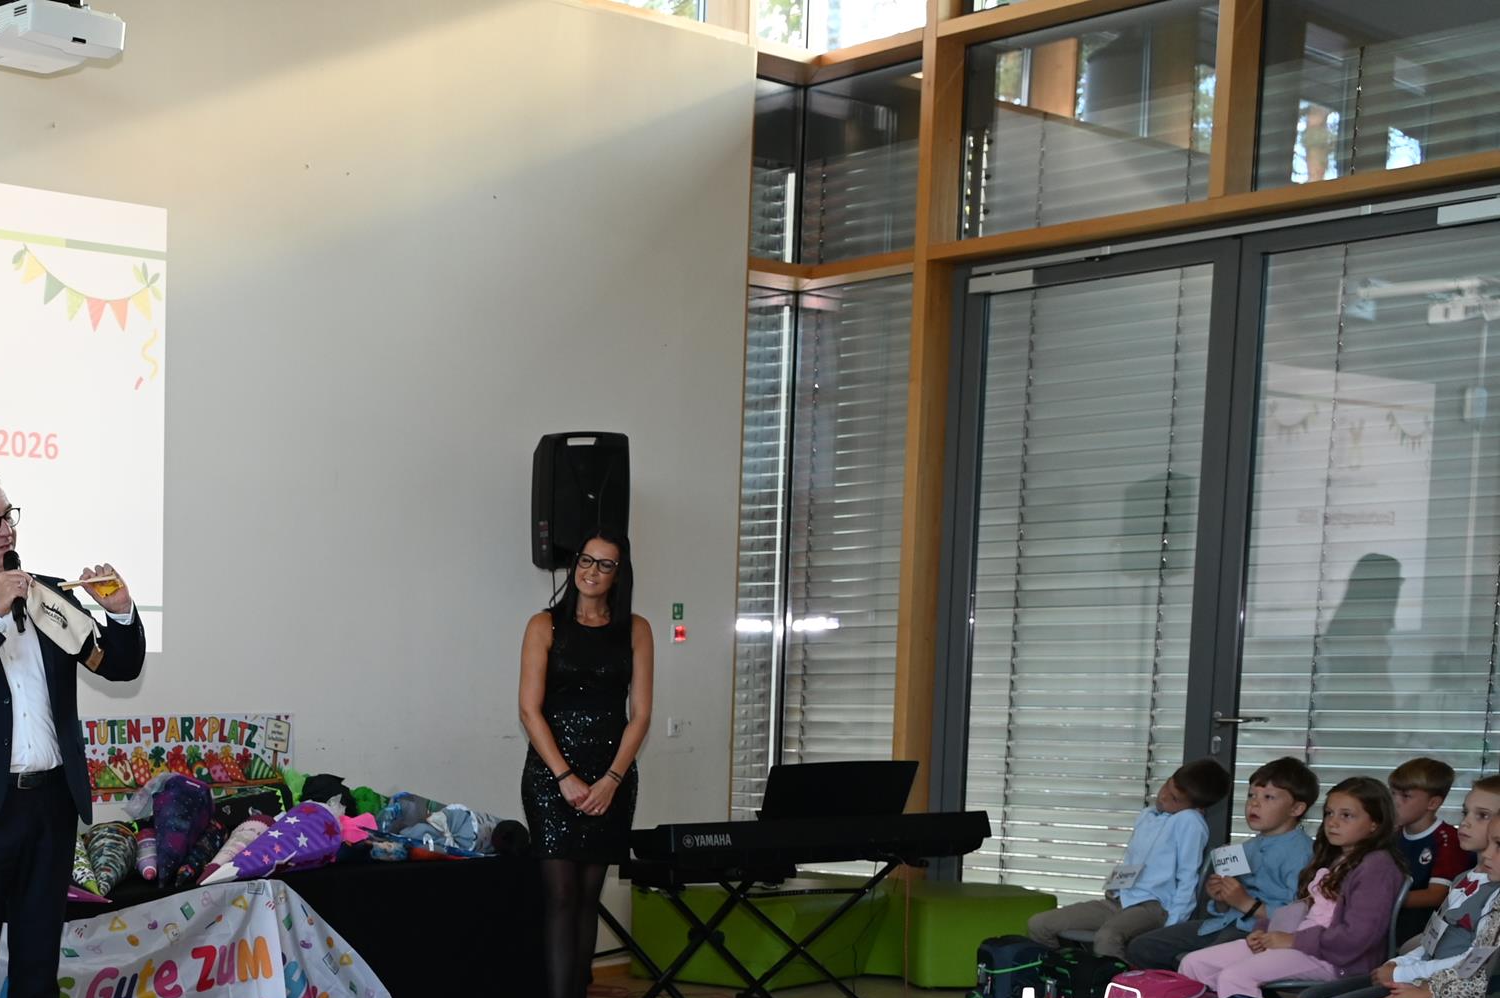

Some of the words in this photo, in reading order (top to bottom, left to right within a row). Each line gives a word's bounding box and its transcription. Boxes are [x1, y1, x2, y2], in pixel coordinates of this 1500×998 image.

[83, 715, 259, 749] TÜTEN-PARKPLATZ
[694, 833, 732, 847] YAMAHA
[191, 935, 273, 993] ZUM
